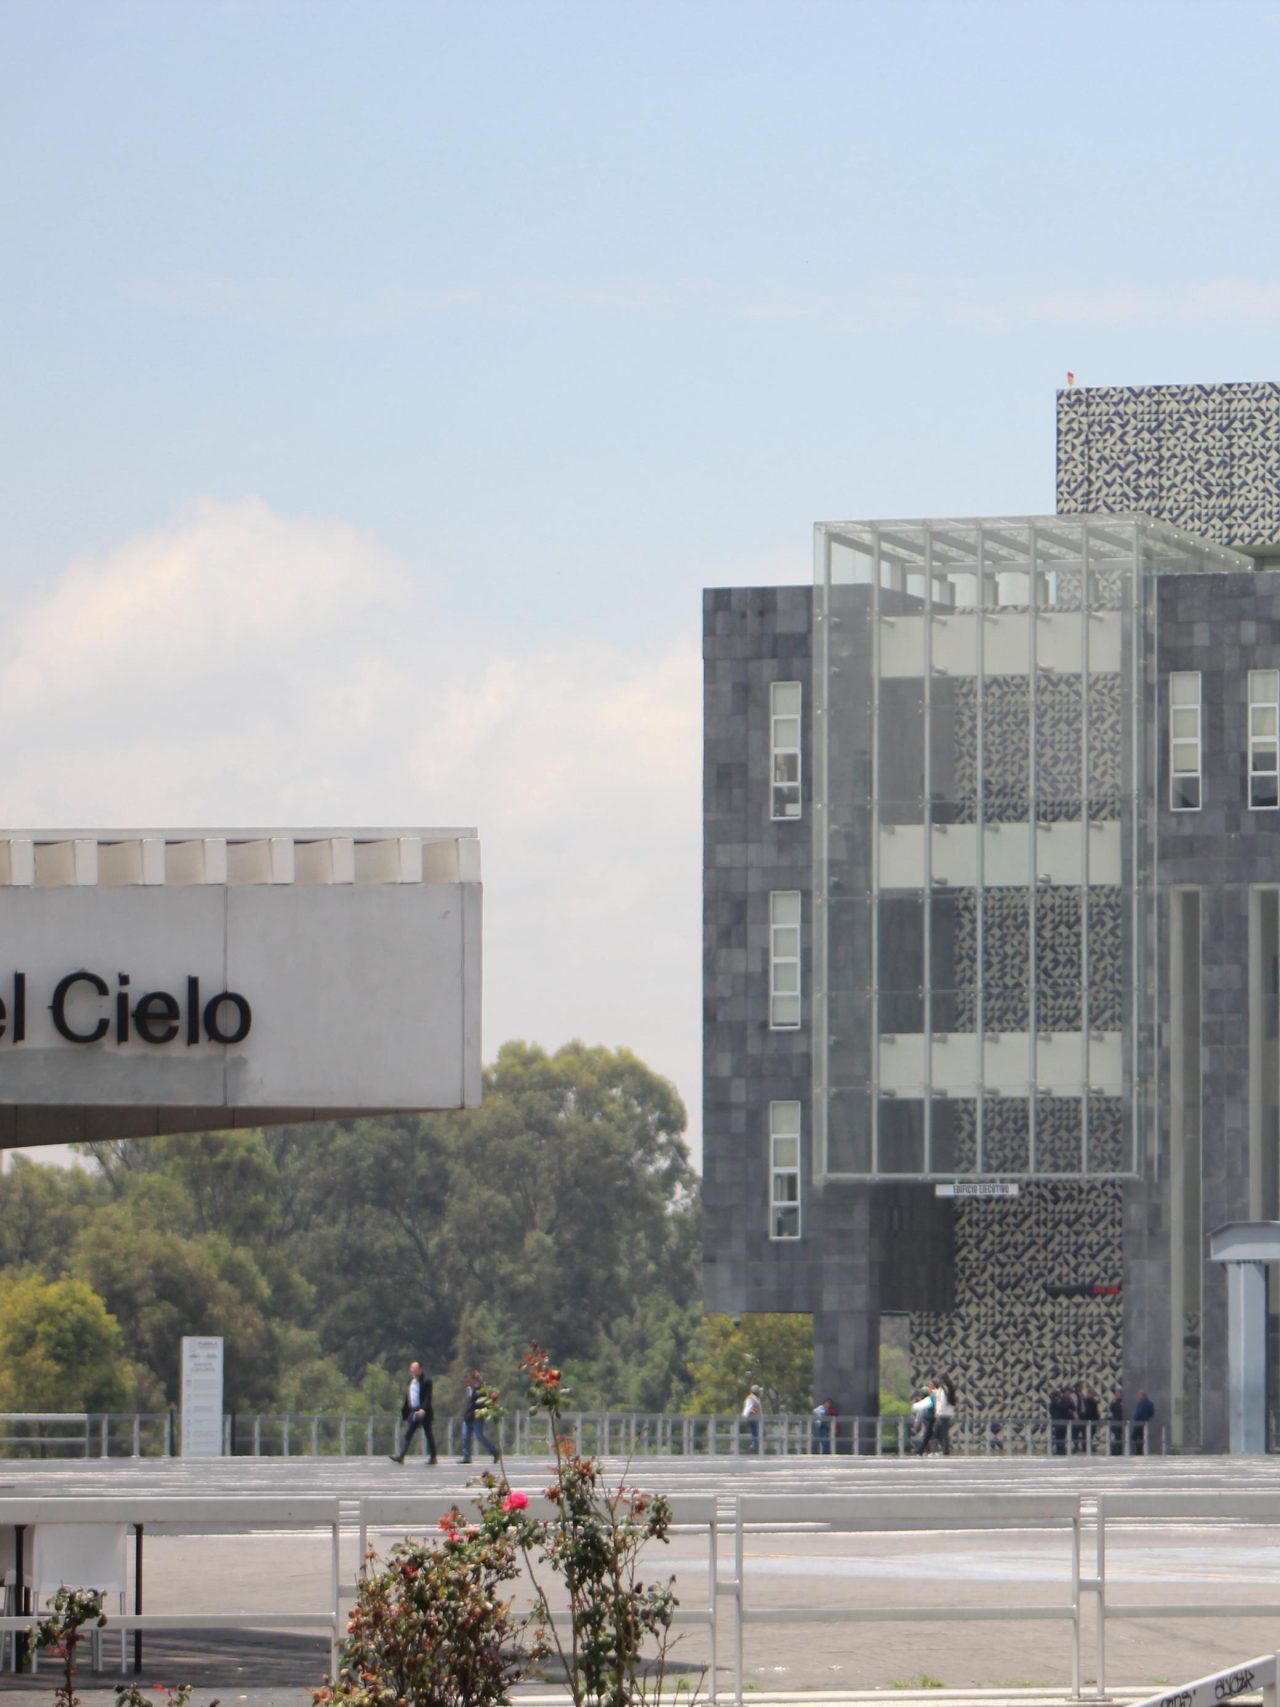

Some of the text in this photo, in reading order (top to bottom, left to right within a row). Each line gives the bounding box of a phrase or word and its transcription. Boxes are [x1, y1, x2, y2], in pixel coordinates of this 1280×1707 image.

[0, 970, 252, 1045] l Cielo
[953, 1184, 978, 1194] EDIFICIO
